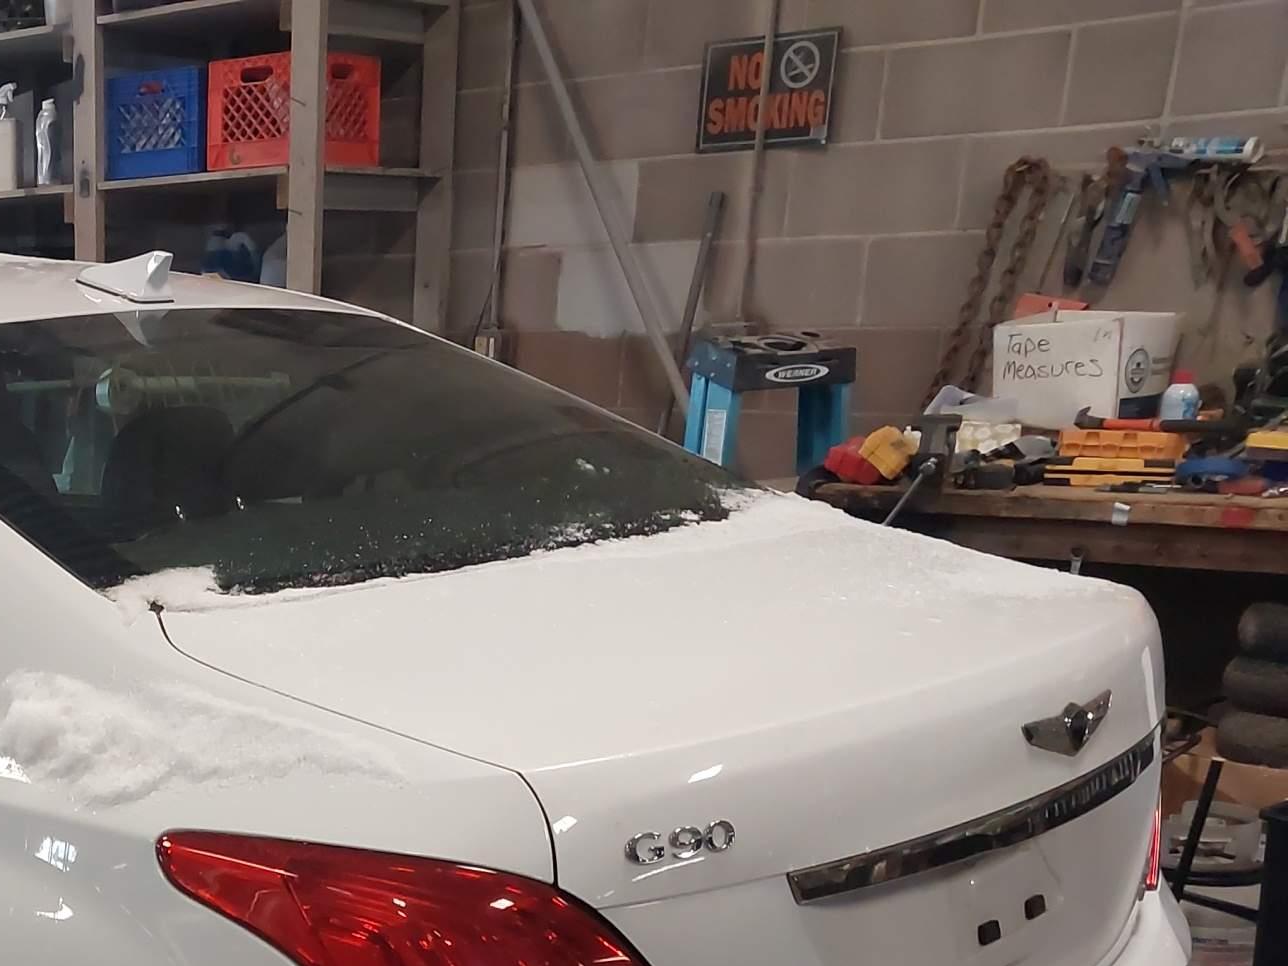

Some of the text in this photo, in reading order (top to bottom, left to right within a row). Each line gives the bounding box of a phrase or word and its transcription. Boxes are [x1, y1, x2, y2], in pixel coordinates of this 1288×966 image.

[727, 52, 767, 91] NO
[706, 89, 826, 135] SMOKING
[1008, 333, 1050, 359] Tape
[624, 819, 736, 865] G90
